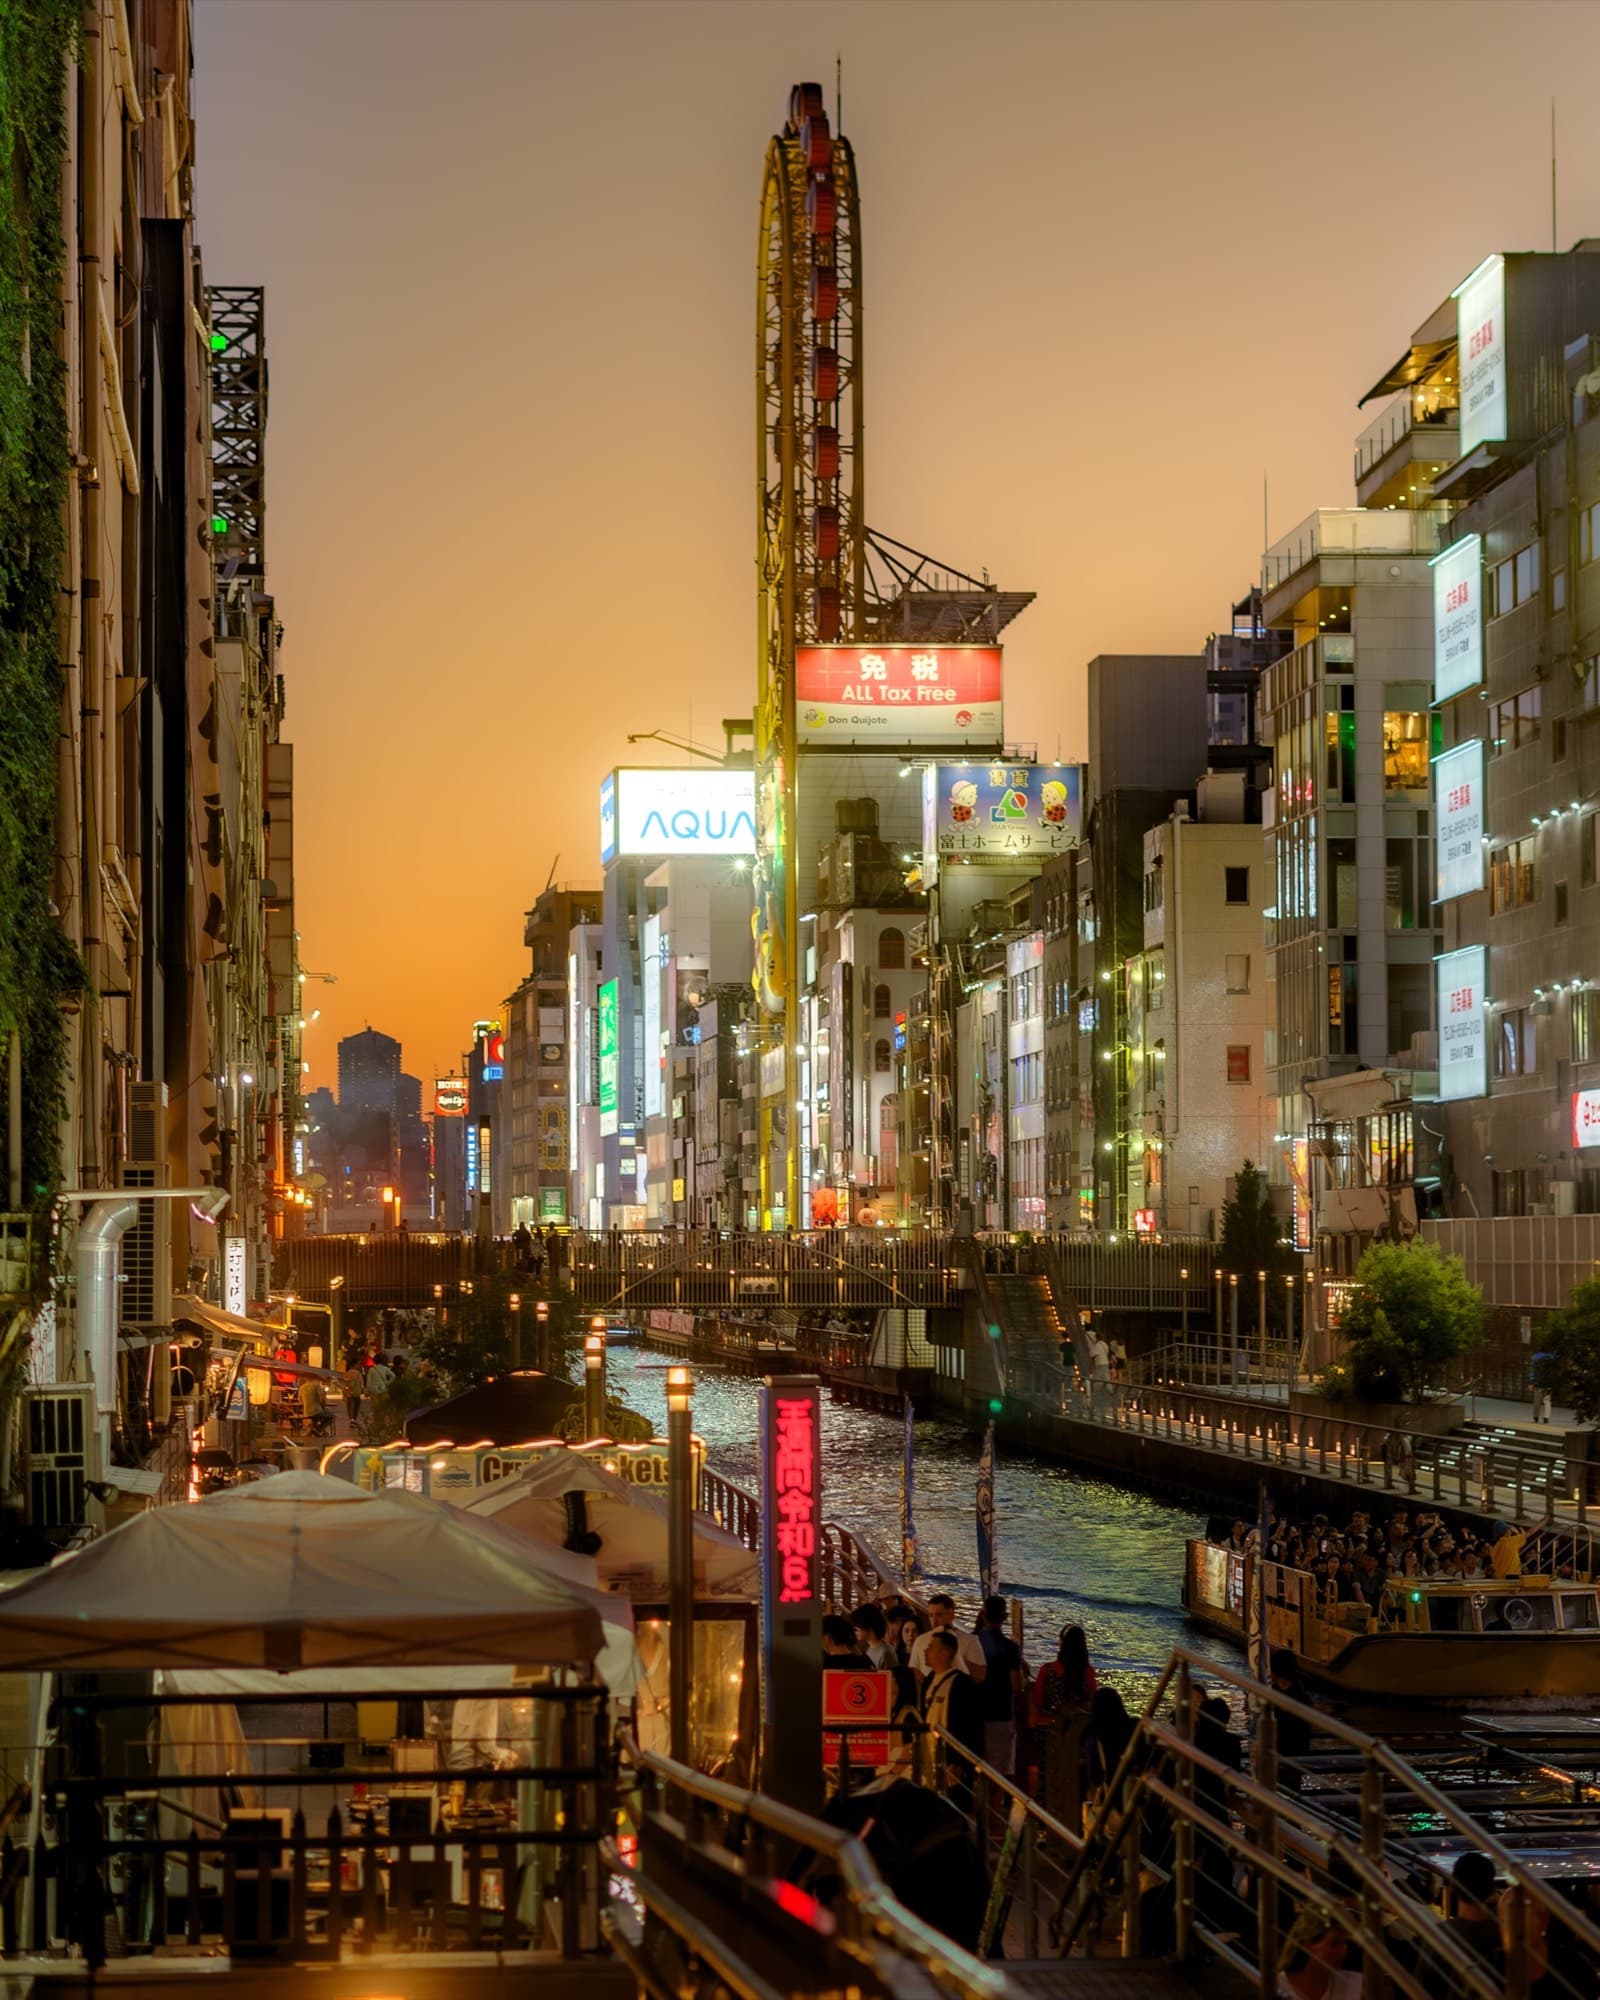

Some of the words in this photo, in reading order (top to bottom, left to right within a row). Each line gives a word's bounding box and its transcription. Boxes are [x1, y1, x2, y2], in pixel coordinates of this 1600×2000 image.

[859, 654, 939, 681] 免税
[842, 685, 873, 701] ALL
[879, 685, 910, 701] Tax
[917, 685, 957, 701] Free
[828, 716, 848, 725] Don
[851, 716, 888, 726] Quijote
[640, 809, 756, 839] AQUA
[940, 834, 1081, 849] 富士ホームサービス
[437, 1080, 467, 1089] HOTEL
[851, 1683, 867, 1706] 3
